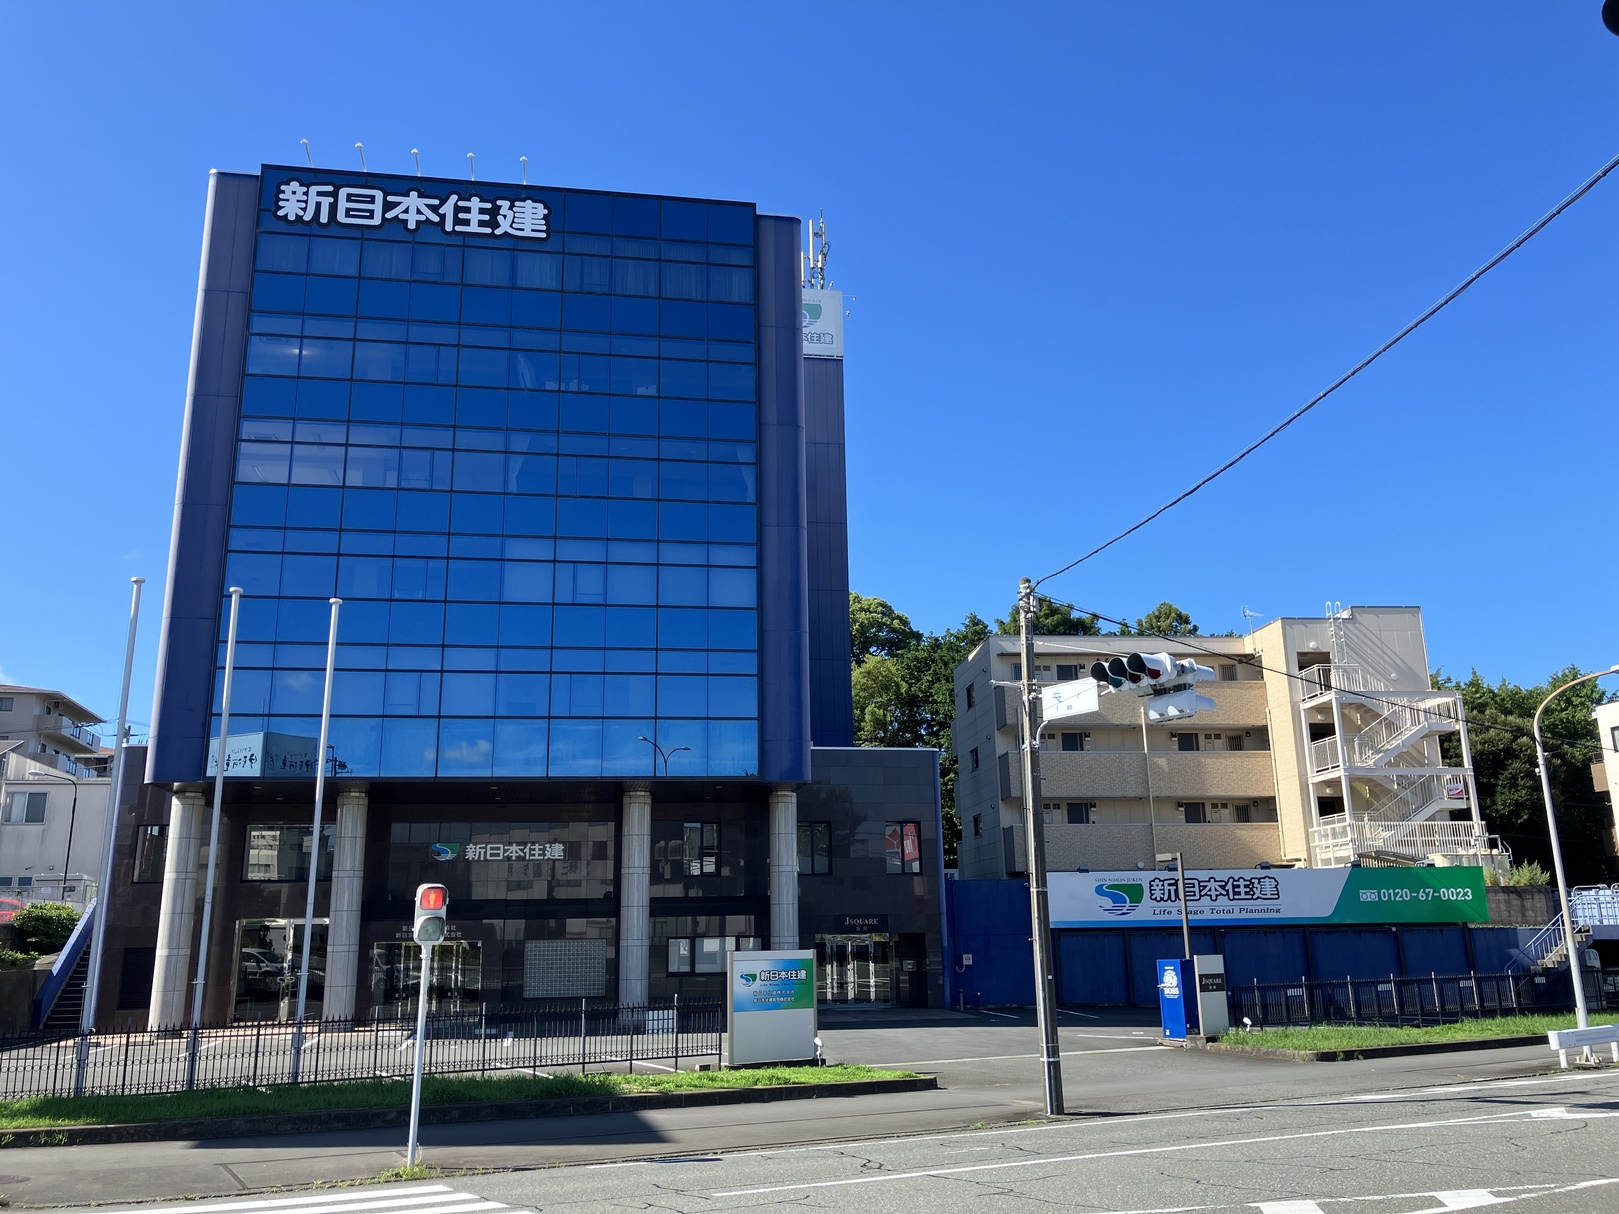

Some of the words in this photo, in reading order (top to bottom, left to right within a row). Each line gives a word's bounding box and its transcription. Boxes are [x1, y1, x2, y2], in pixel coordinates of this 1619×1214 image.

[275, 179, 549, 240] 新日本住建
[465, 842, 564, 861] 新日本住建
[1149, 876, 1281, 902] 新日本住建
[1380, 888, 1473, 901] 0120-67-0023
[1152, 908, 1173, 916] Life
[1176, 908, 1205, 917] Sage
[1210, 907, 1235, 915] Total
[1238, 907, 1282, 916] Planning
[760, 970, 807, 981] 新日本住建
